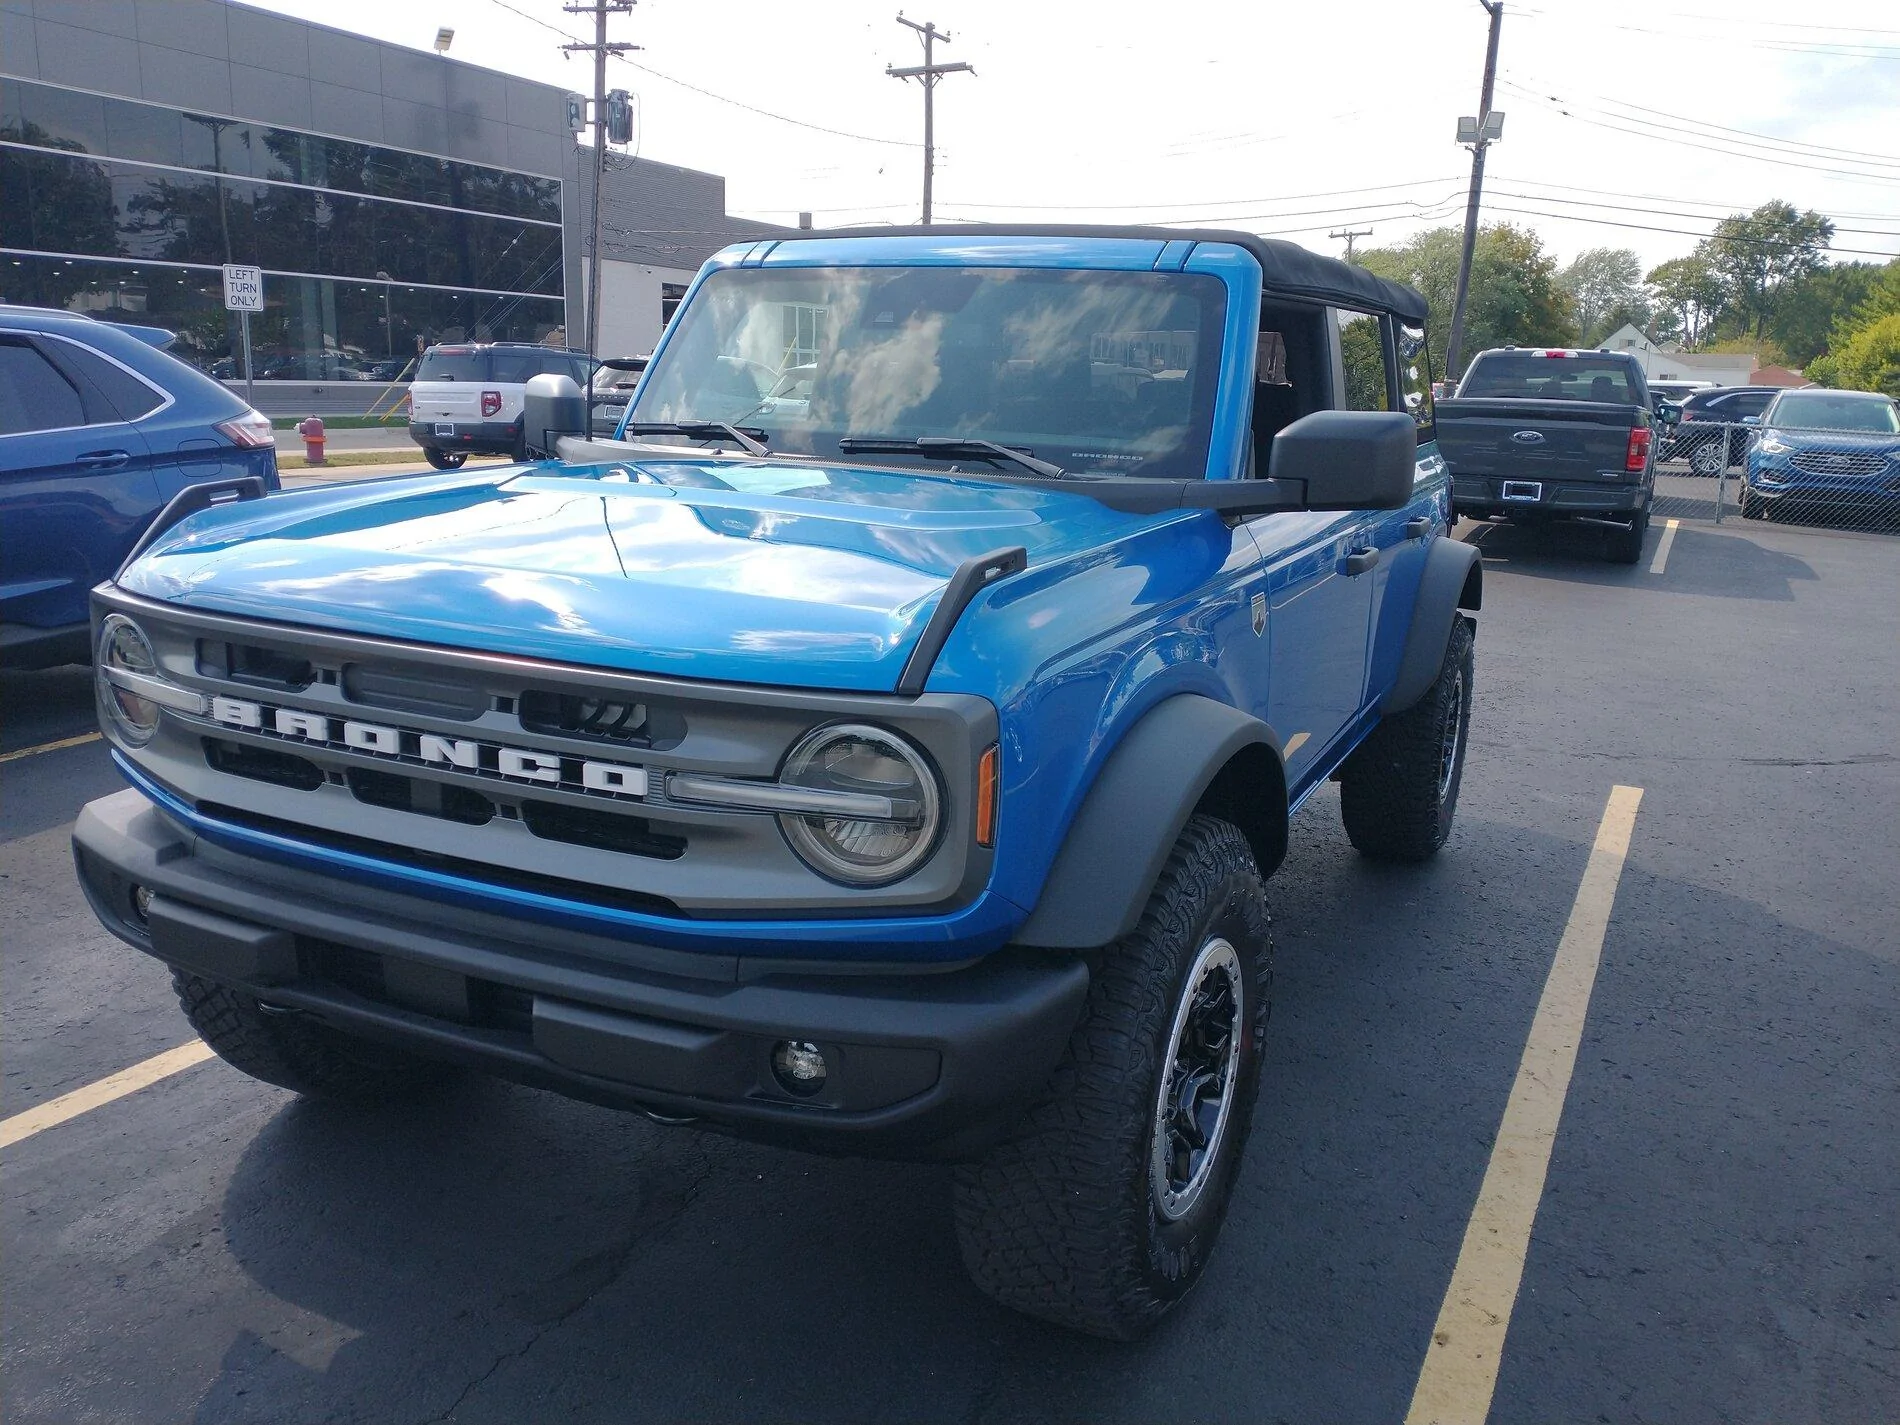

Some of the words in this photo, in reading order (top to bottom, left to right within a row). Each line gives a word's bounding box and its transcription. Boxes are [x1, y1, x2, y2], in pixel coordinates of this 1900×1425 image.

[229, 269, 254, 280] LEFT
[229, 281, 257, 293] TURN
[230, 295, 257, 306] ONLY
[212, 696, 648, 796] BRONCO
